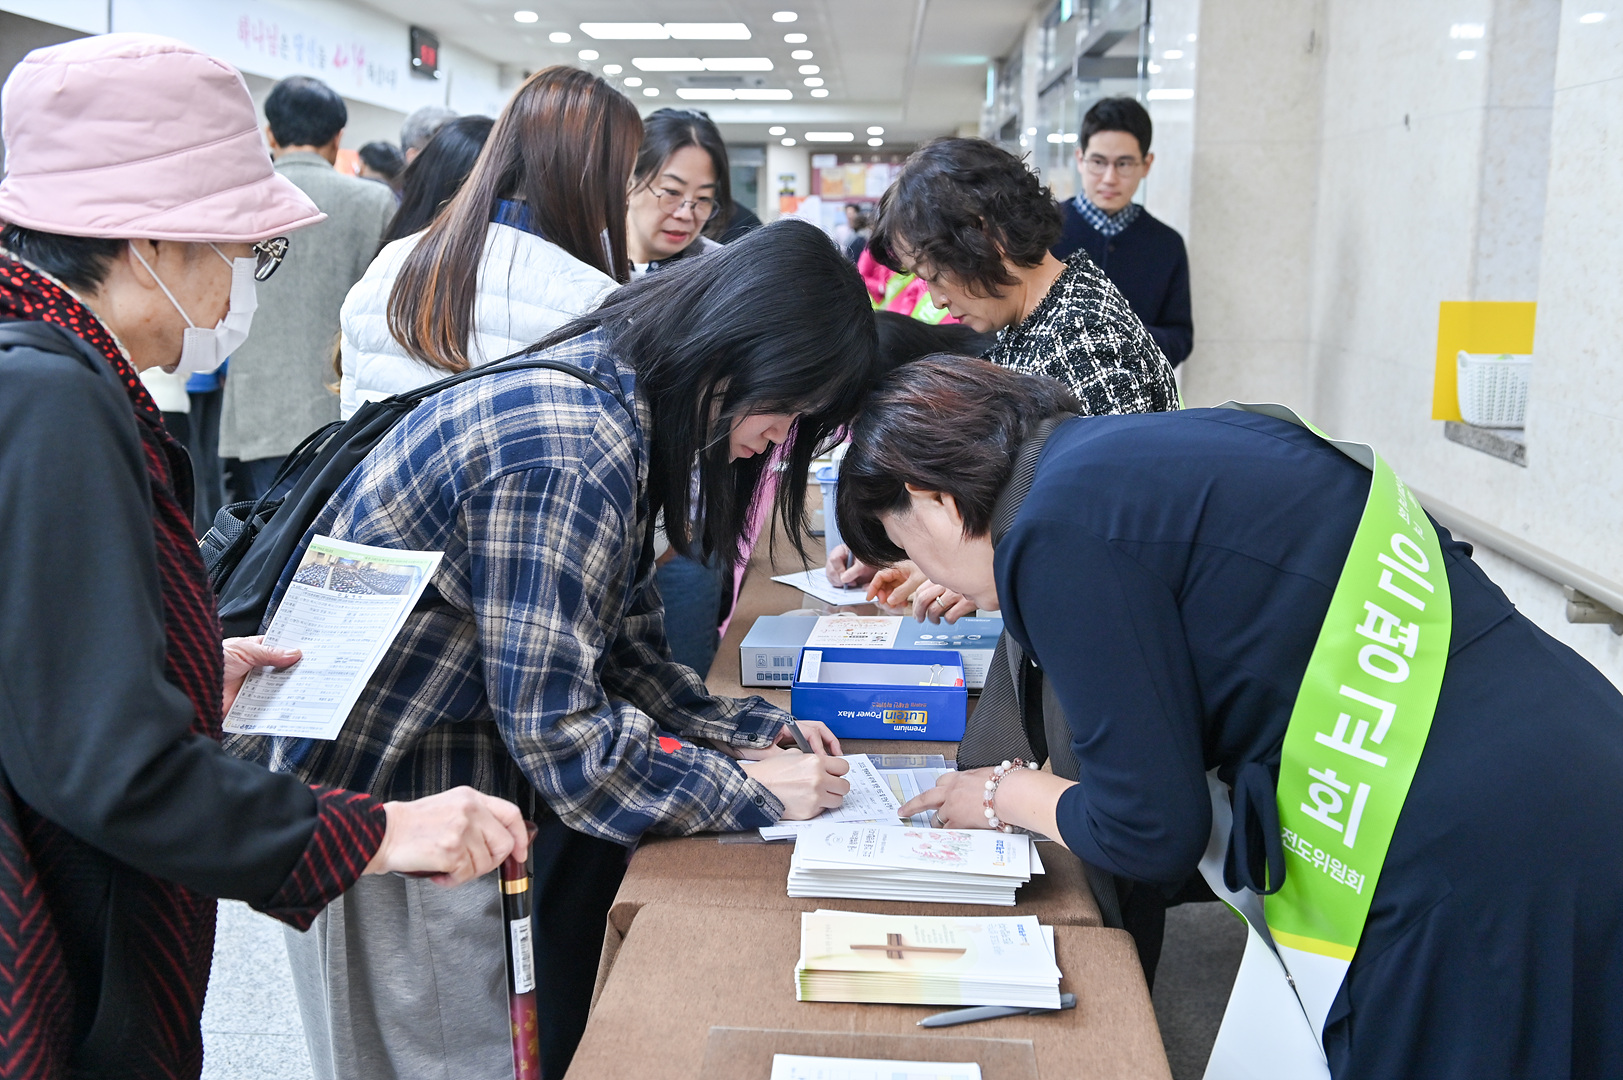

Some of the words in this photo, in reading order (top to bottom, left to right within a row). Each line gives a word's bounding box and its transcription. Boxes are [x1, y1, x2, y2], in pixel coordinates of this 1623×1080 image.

[1299, 532, 1435, 849] 은평교회
[856, 711, 882, 719] Power
[885, 712, 926, 723] Lutein
[893, 725, 927, 733] Premium
[1281, 827, 1366, 895] 전도위원회
